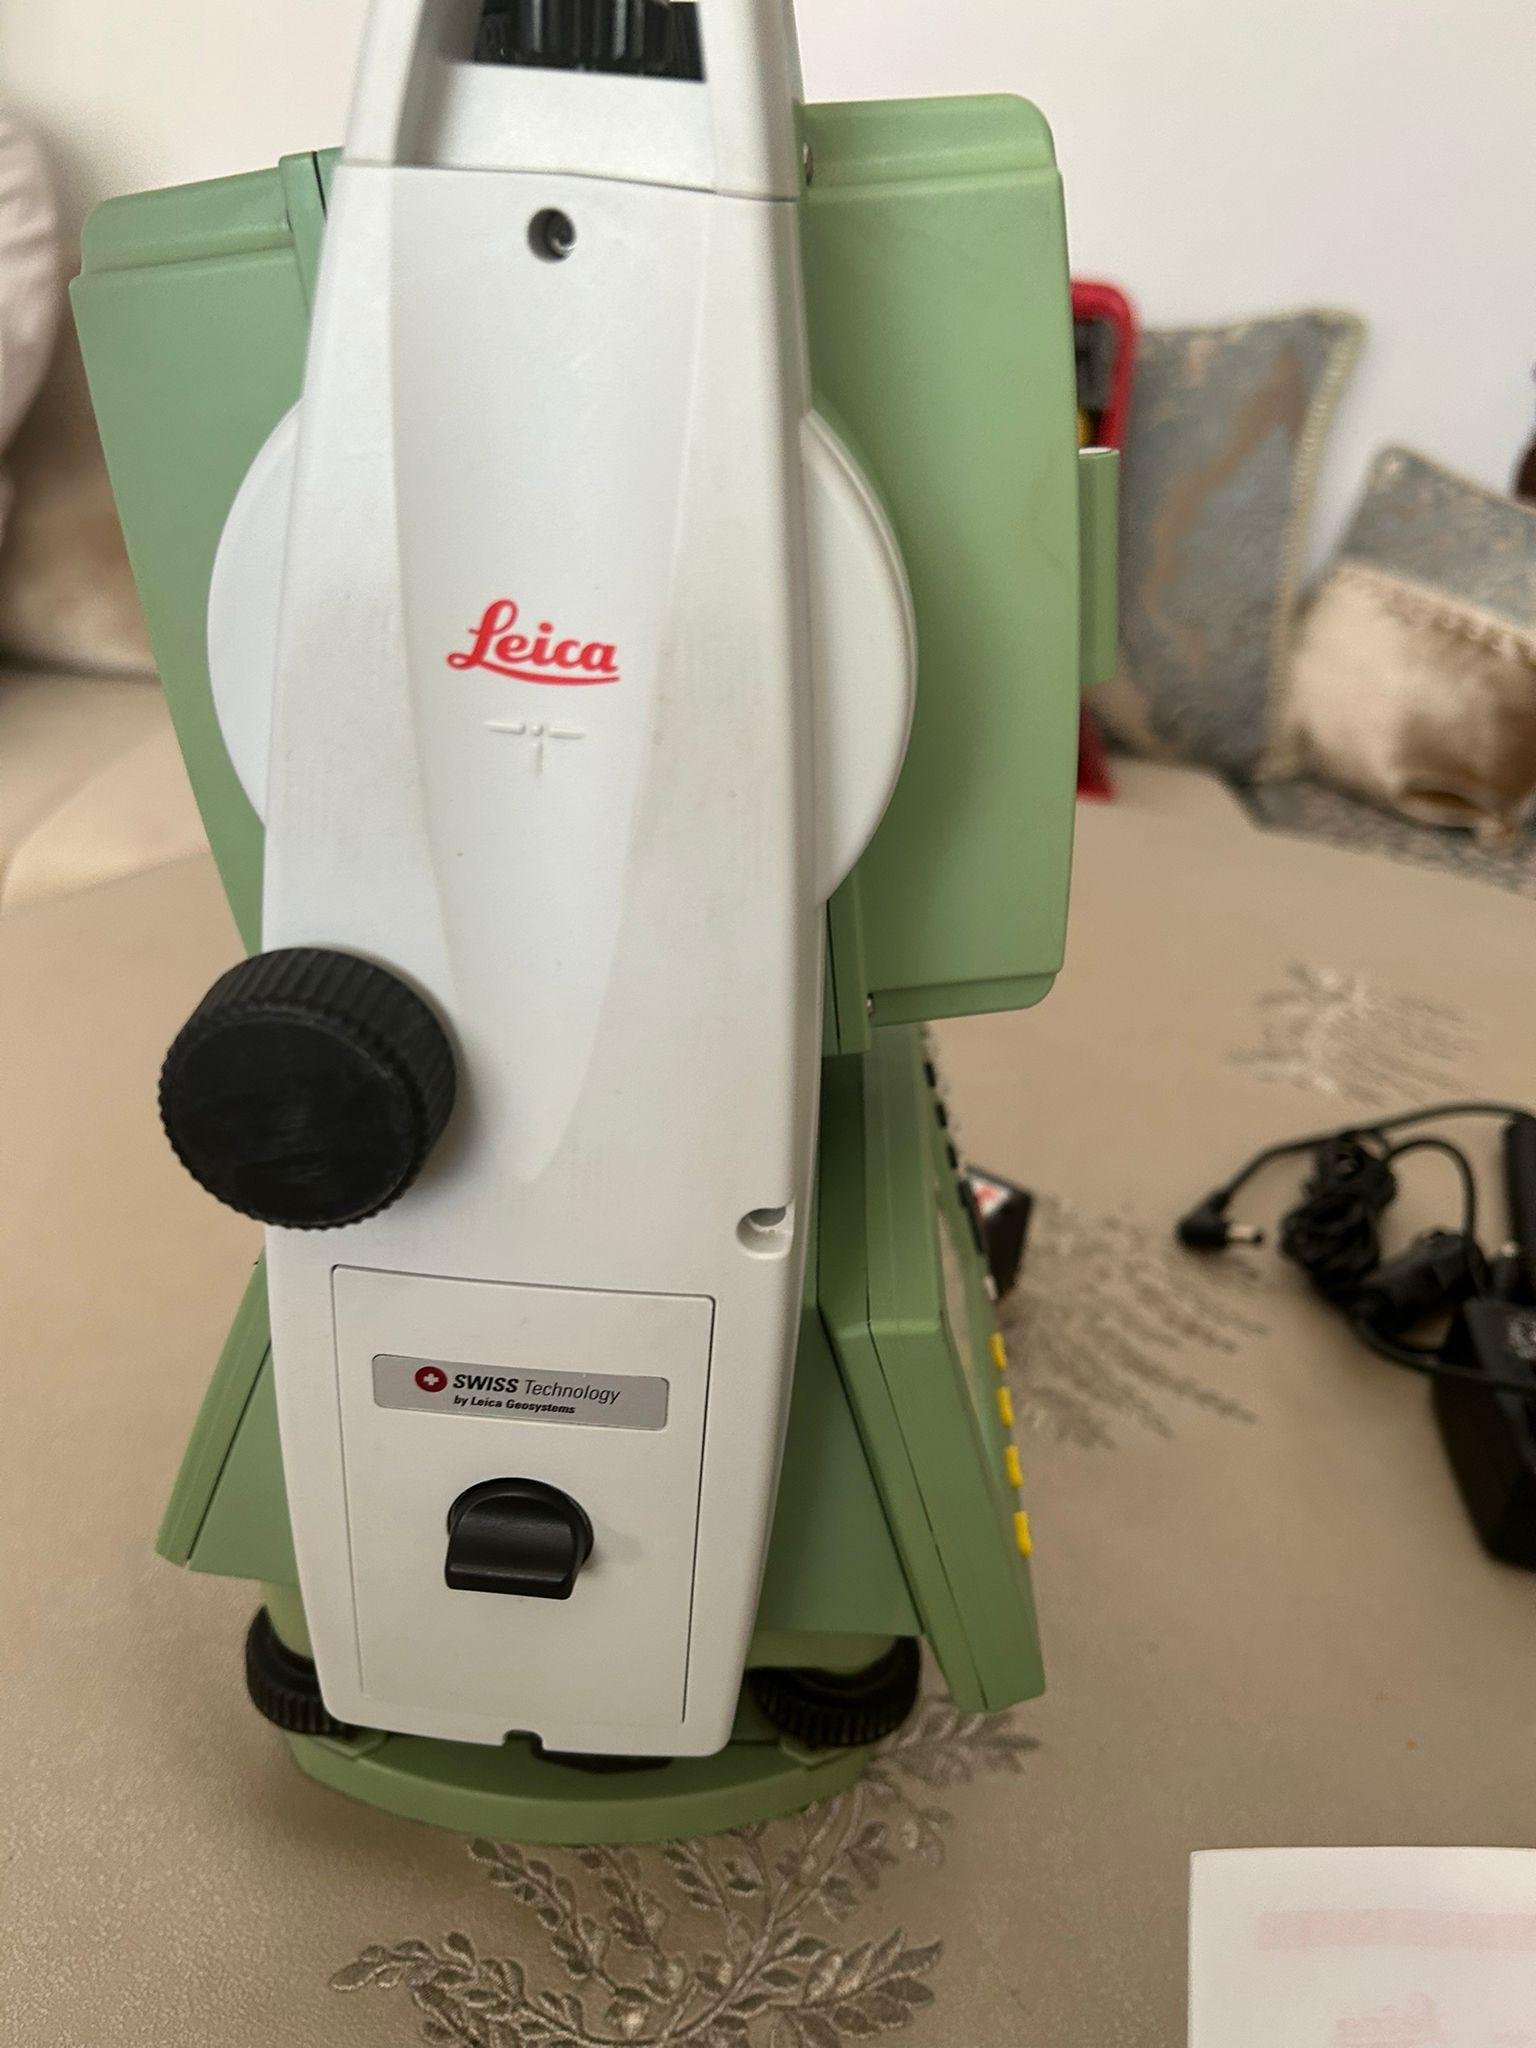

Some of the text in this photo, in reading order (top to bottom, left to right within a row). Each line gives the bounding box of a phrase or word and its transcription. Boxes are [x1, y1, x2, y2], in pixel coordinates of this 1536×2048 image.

[447, 599, 620, 686] Leica
[453, 1374, 621, 1405] SWISS Technology
[453, 1395, 576, 1415] by Leica Geosystems
